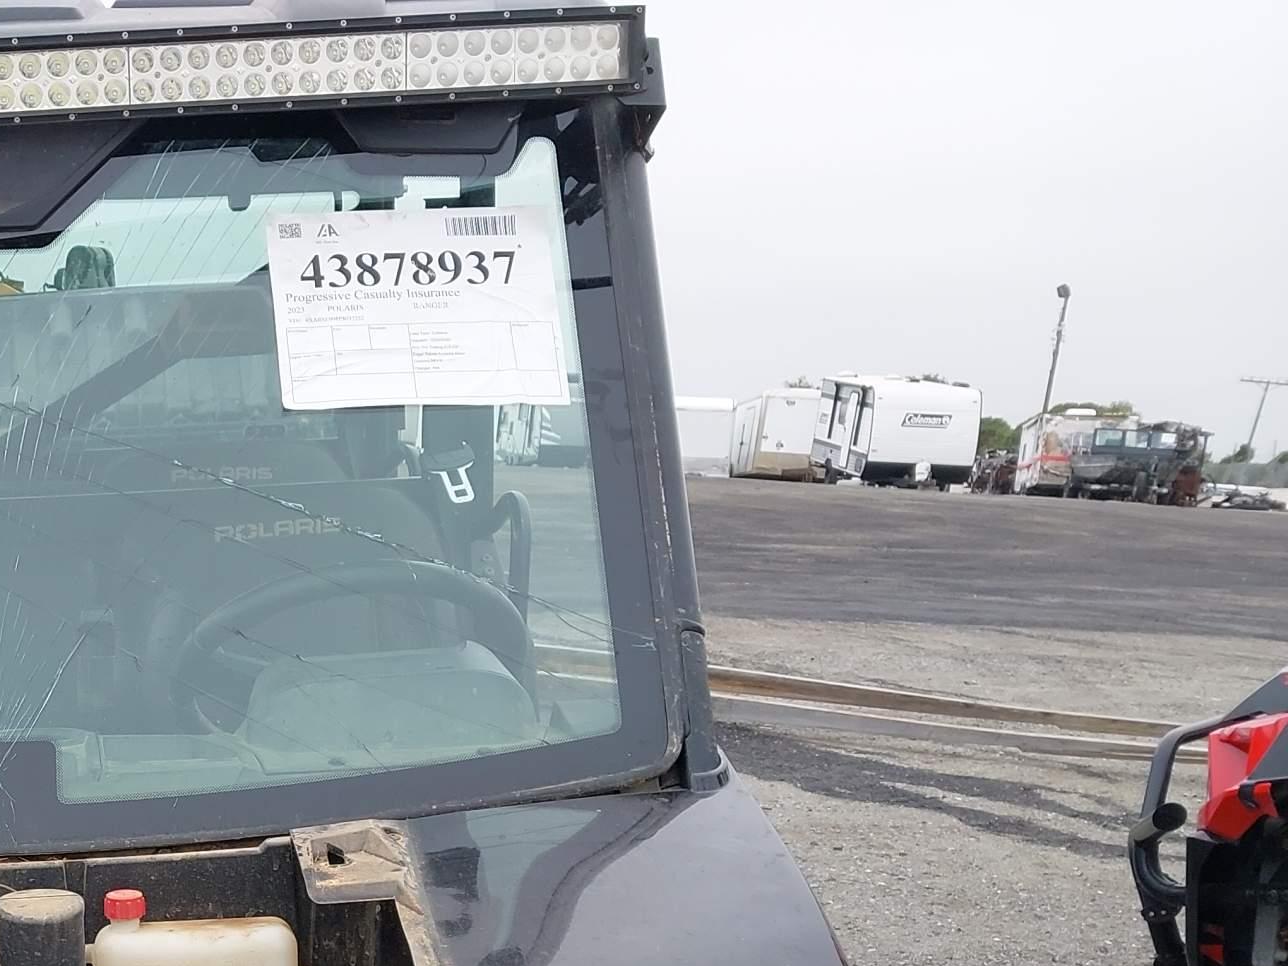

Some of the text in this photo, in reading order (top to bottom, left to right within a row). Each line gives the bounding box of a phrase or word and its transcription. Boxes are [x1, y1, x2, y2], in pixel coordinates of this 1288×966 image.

[300, 250, 516, 289] 43878937
[285, 287, 461, 305] Progressive Casualty Insurance
[905, 413, 943, 425] Coleman
[172, 466, 273, 483] POLARIS
[214, 517, 341, 543] POLARIS
